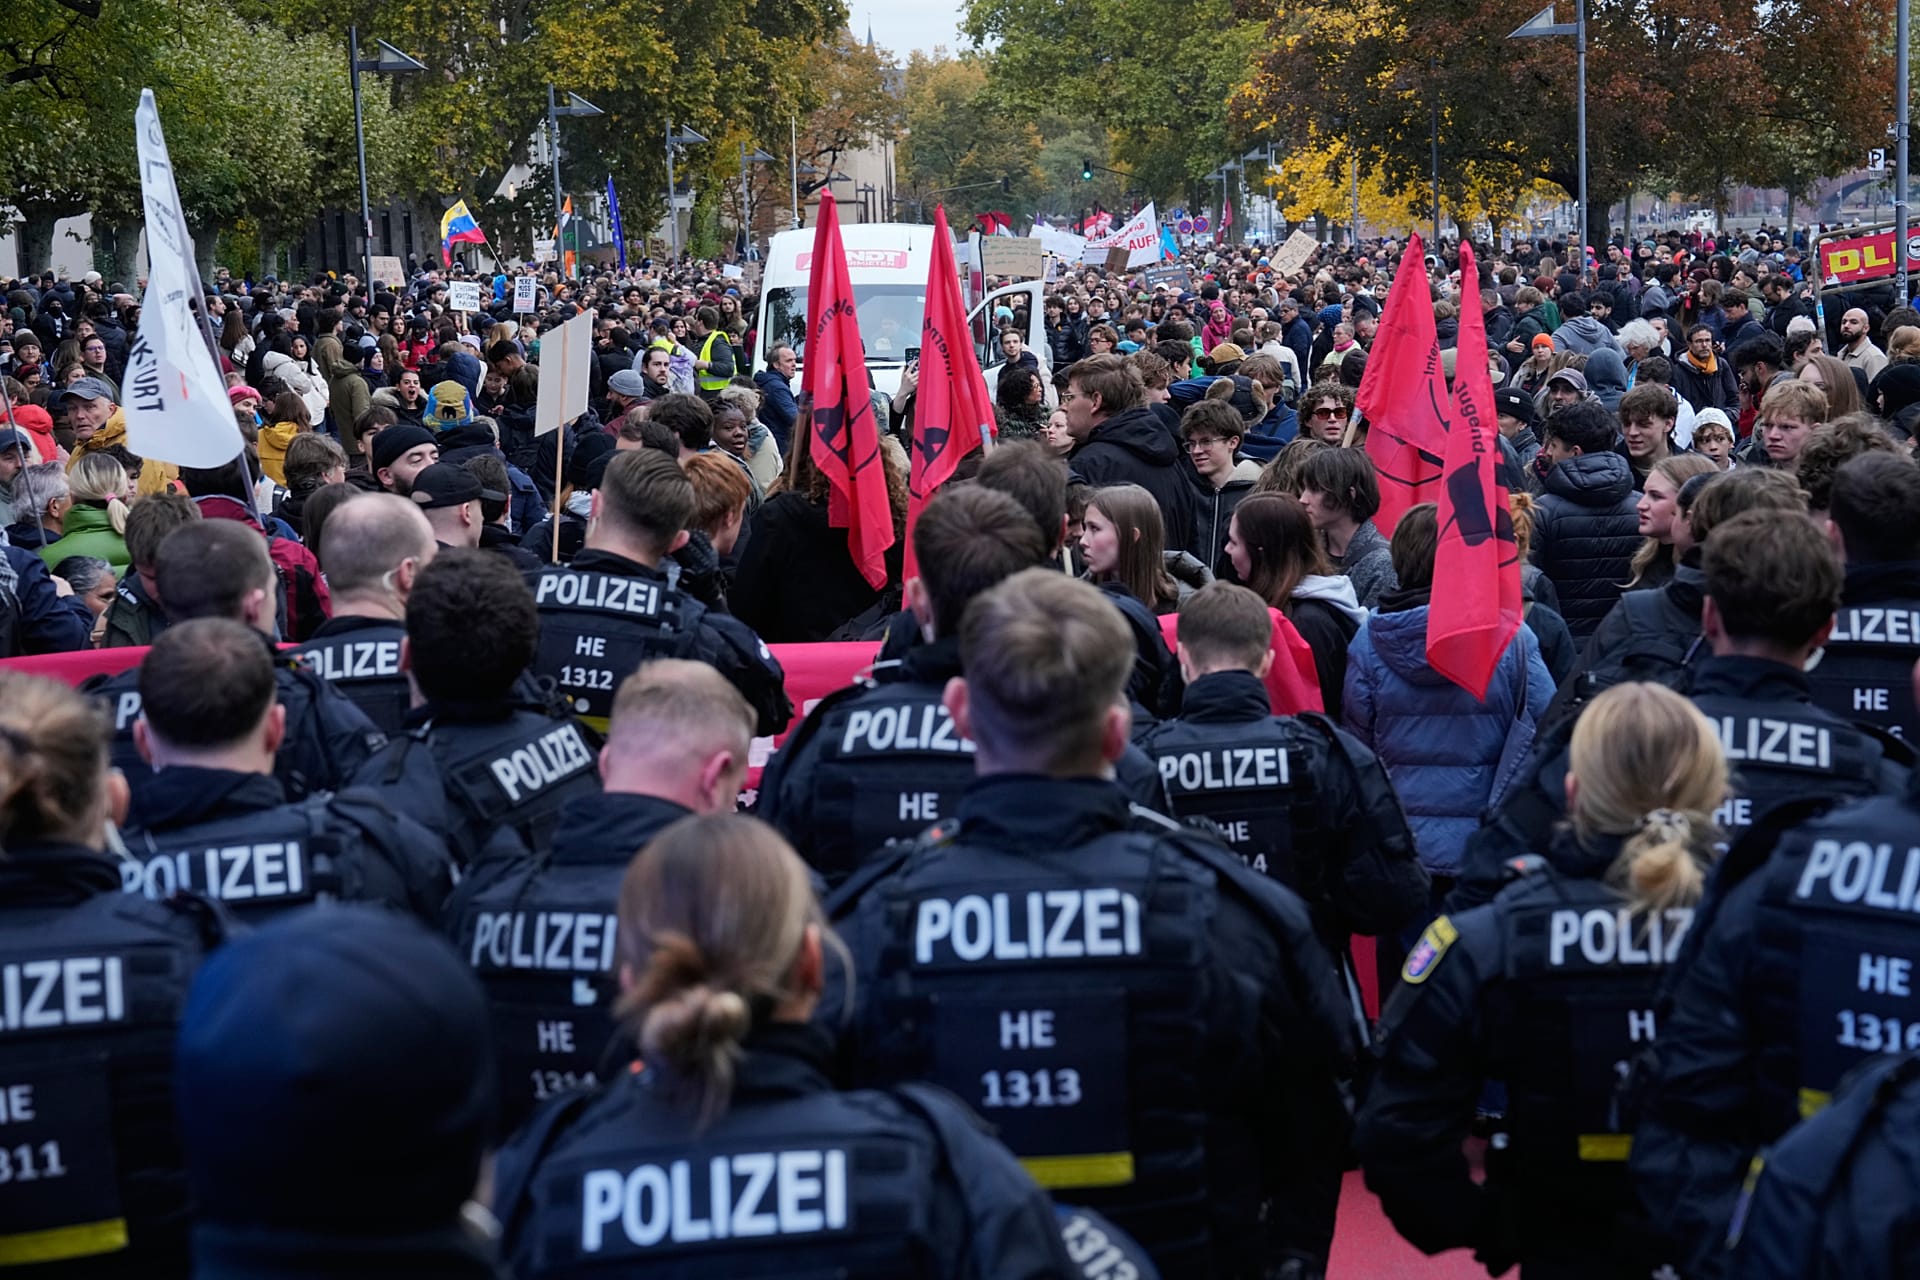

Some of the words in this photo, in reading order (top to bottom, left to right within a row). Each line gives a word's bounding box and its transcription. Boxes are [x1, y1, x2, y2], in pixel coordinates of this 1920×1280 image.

[1129, 234, 1156, 250] AUF!
[1455, 381, 1486, 454] Jugend
[536, 574, 658, 615] POLIZEI
[575, 635, 607, 657] HE
[1828, 608, 1920, 645] LIZEI
[560, 665, 614, 690] 1312
[1853, 687, 1889, 711] HE
[491, 724, 592, 801] POLIZEI
[1158, 748, 1289, 790] POLIZEI
[899, 792, 940, 821] HE
[471, 911, 618, 972] POLIZEI
[915, 889, 1141, 964] POLIZEI
[1550, 909, 1696, 966] POLIZ
[0, 956, 125, 1032] IZEI
[1857, 952, 1913, 997] HE
[536, 1020, 577, 1053] HE
[1000, 1010, 1056, 1049] HE
[980, 1067, 1083, 1108] 1313
[582, 1149, 847, 1252] POLIZEI
